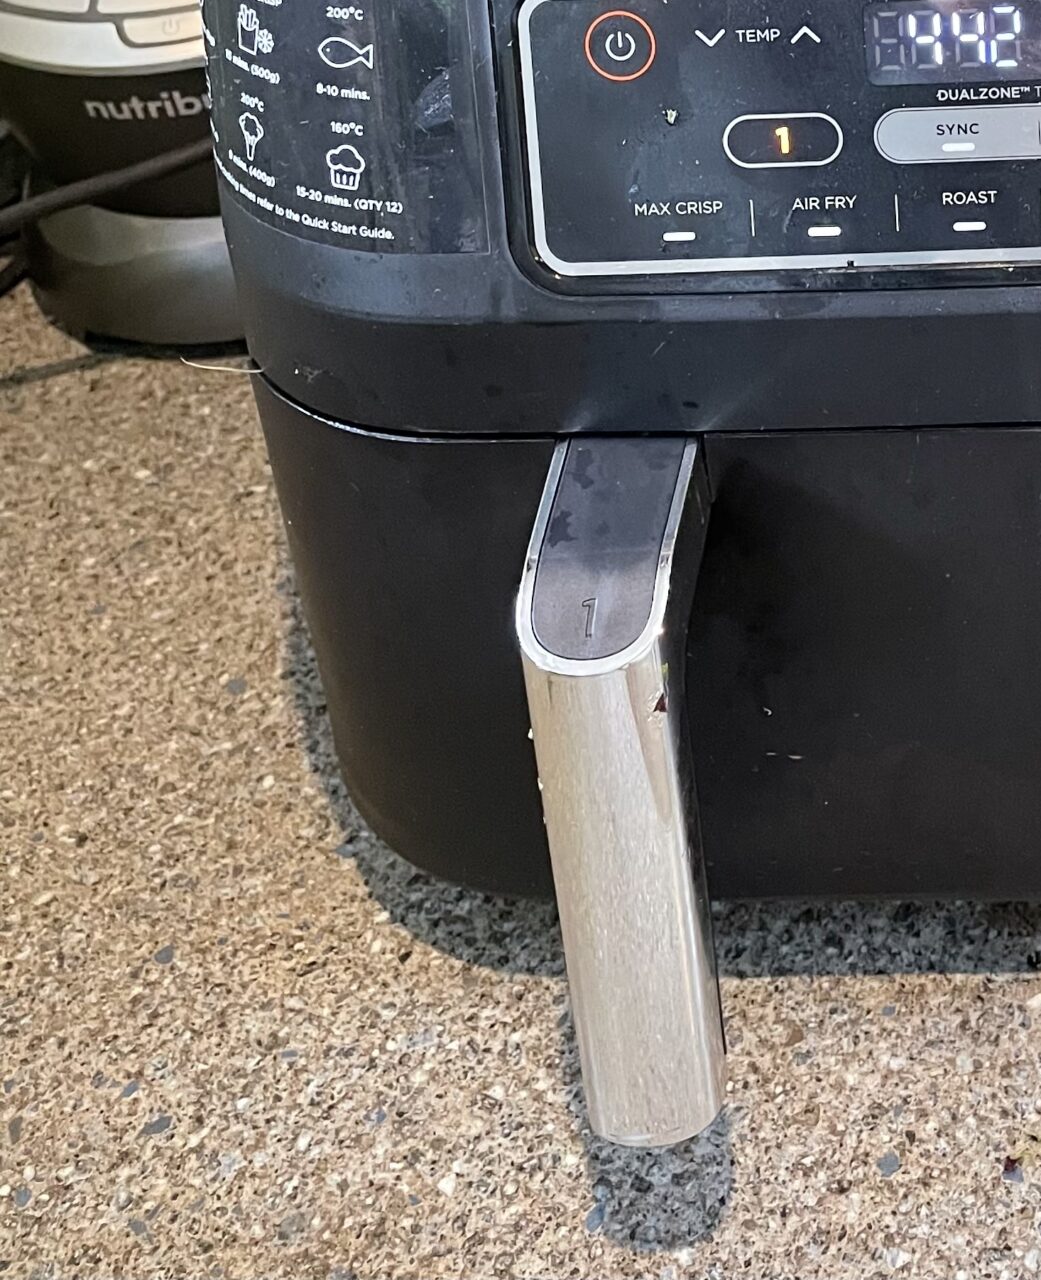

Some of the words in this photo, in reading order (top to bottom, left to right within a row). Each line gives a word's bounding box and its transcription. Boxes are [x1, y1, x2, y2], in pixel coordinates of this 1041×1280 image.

[326, 6, 364, 21] 200°C
[735, 28, 780, 44] TEMP
[340, 87, 371, 101] mins.
[936, 122, 980, 136] SYNC
[774, 126, 791, 154] 1
[323, 194, 352, 208] mins.
[354, 197, 382, 212] (QTY
[385, 200, 404, 215] 12)
[792, 197, 821, 211] AIR
[825, 195, 857, 210] FRY
[942, 190, 998, 206] ROAST
[634, 201, 671, 216] MAX
[676, 200, 723, 216] CRISP
[274, 203, 285, 216] to
[285, 208, 300, 223] the
[301, 213, 329, 231] Quick
[331, 220, 357, 236] Start
[359, 225, 395, 240] Guide.
[581, 597, 598, 639] 1
